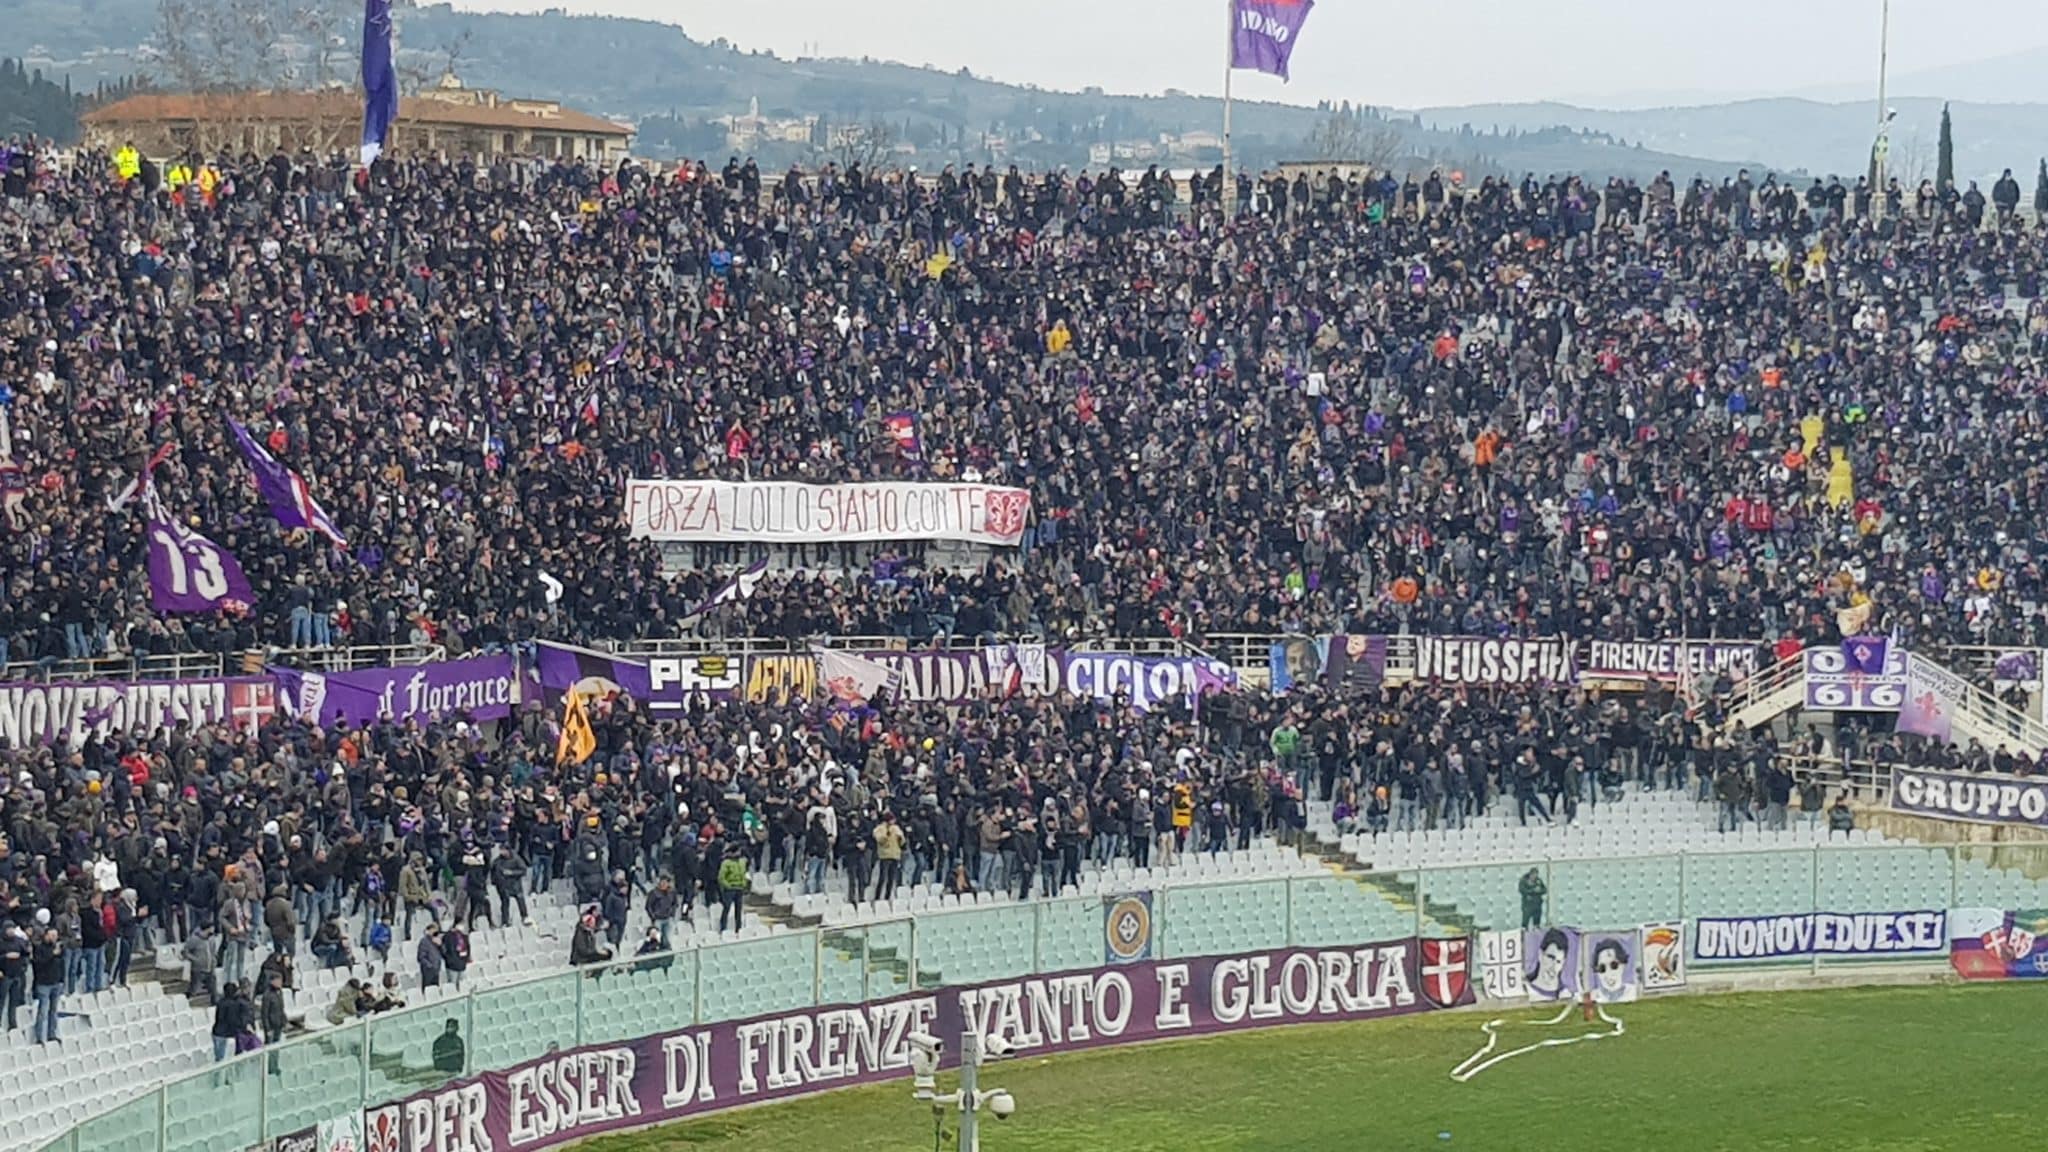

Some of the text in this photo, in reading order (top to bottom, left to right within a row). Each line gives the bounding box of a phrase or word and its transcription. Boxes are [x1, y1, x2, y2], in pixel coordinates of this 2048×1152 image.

[628, 484, 720, 533] FORZA
[731, 485, 810, 533] LOLLO
[817, 487, 898, 534] SIAMO
[153, 529, 228, 602] 13
[1590, 640, 1671, 673] FIRENZE
[1900, 774, 2046, 820] GRUPPO
[1697, 912, 1944, 957] UNONOVEDUESEI
[406, 945, 1415, 1152] PER ESSER DI FIRENZE VANTO E GLORIA
